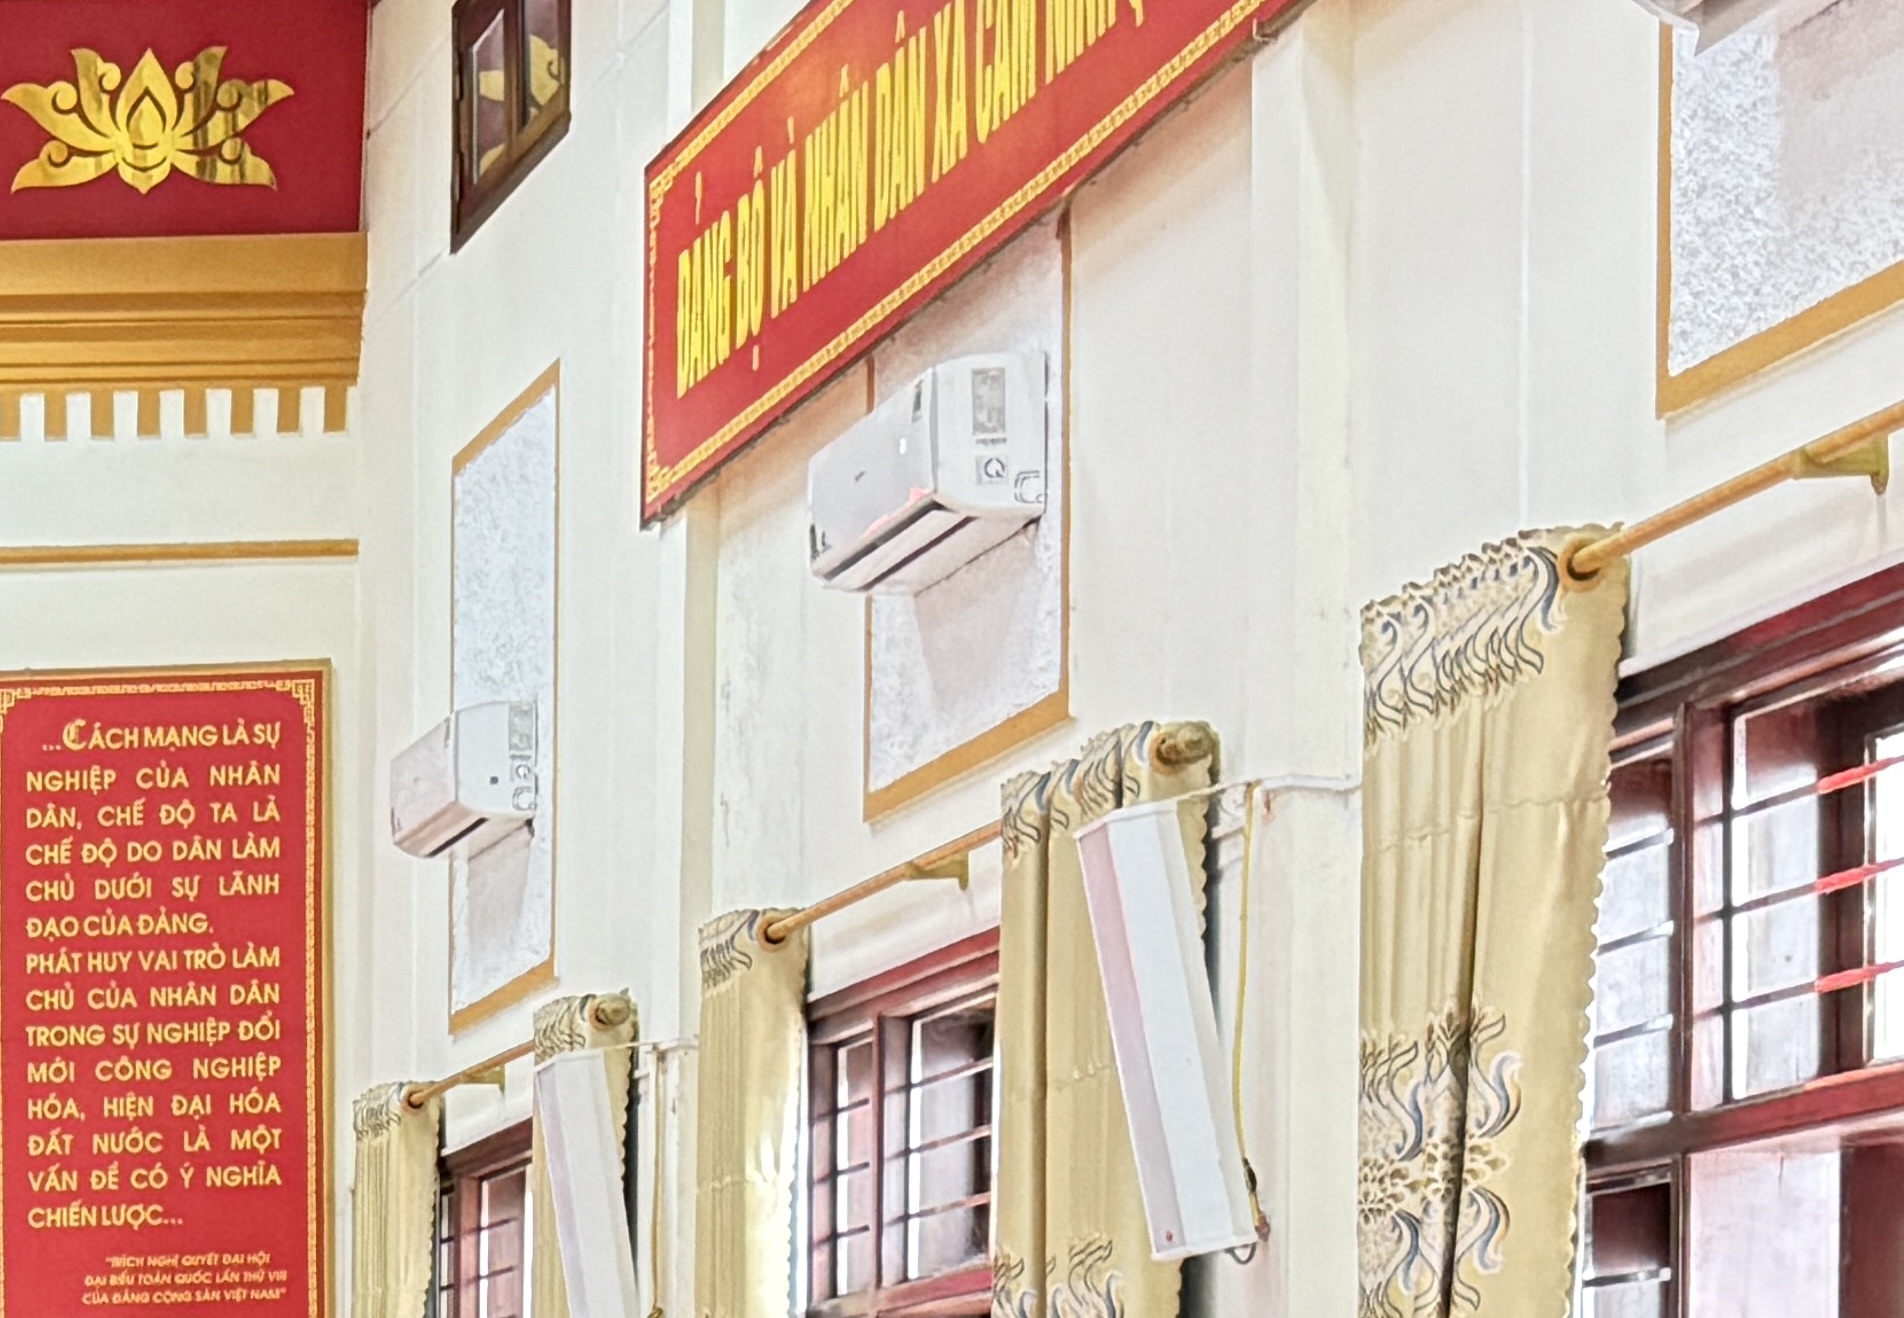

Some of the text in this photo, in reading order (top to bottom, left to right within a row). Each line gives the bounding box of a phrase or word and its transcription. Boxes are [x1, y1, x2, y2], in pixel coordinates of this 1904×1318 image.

[677, 172, 731, 398] ĐẢNG
[736, 146, 765, 370] BỘ
[771, 116, 797, 319] VÀ
[803, 66, 868, 291] NHÂN
[874, 11, 926, 232] DÂN
[144, 725, 218, 751] MẠNG
[253, 722, 280, 748] SỰ
[27, 803, 82, 829] DÂN,
[97, 798, 145, 826] CHẾ
[159, 799, 195, 828] ĐỘ
[210, 803, 237, 822] TA
[28, 1052, 281, 1083] MỚI CÔNG NGHIỆP
[28, 1087, 281, 1120] HÓA, HIỆN ĐẠI HÓA
[28, 1128, 73, 1156] ĐẤT
[93, 1127, 162, 1154] NƯỚC
[231, 1125, 281, 1154] MỘT
